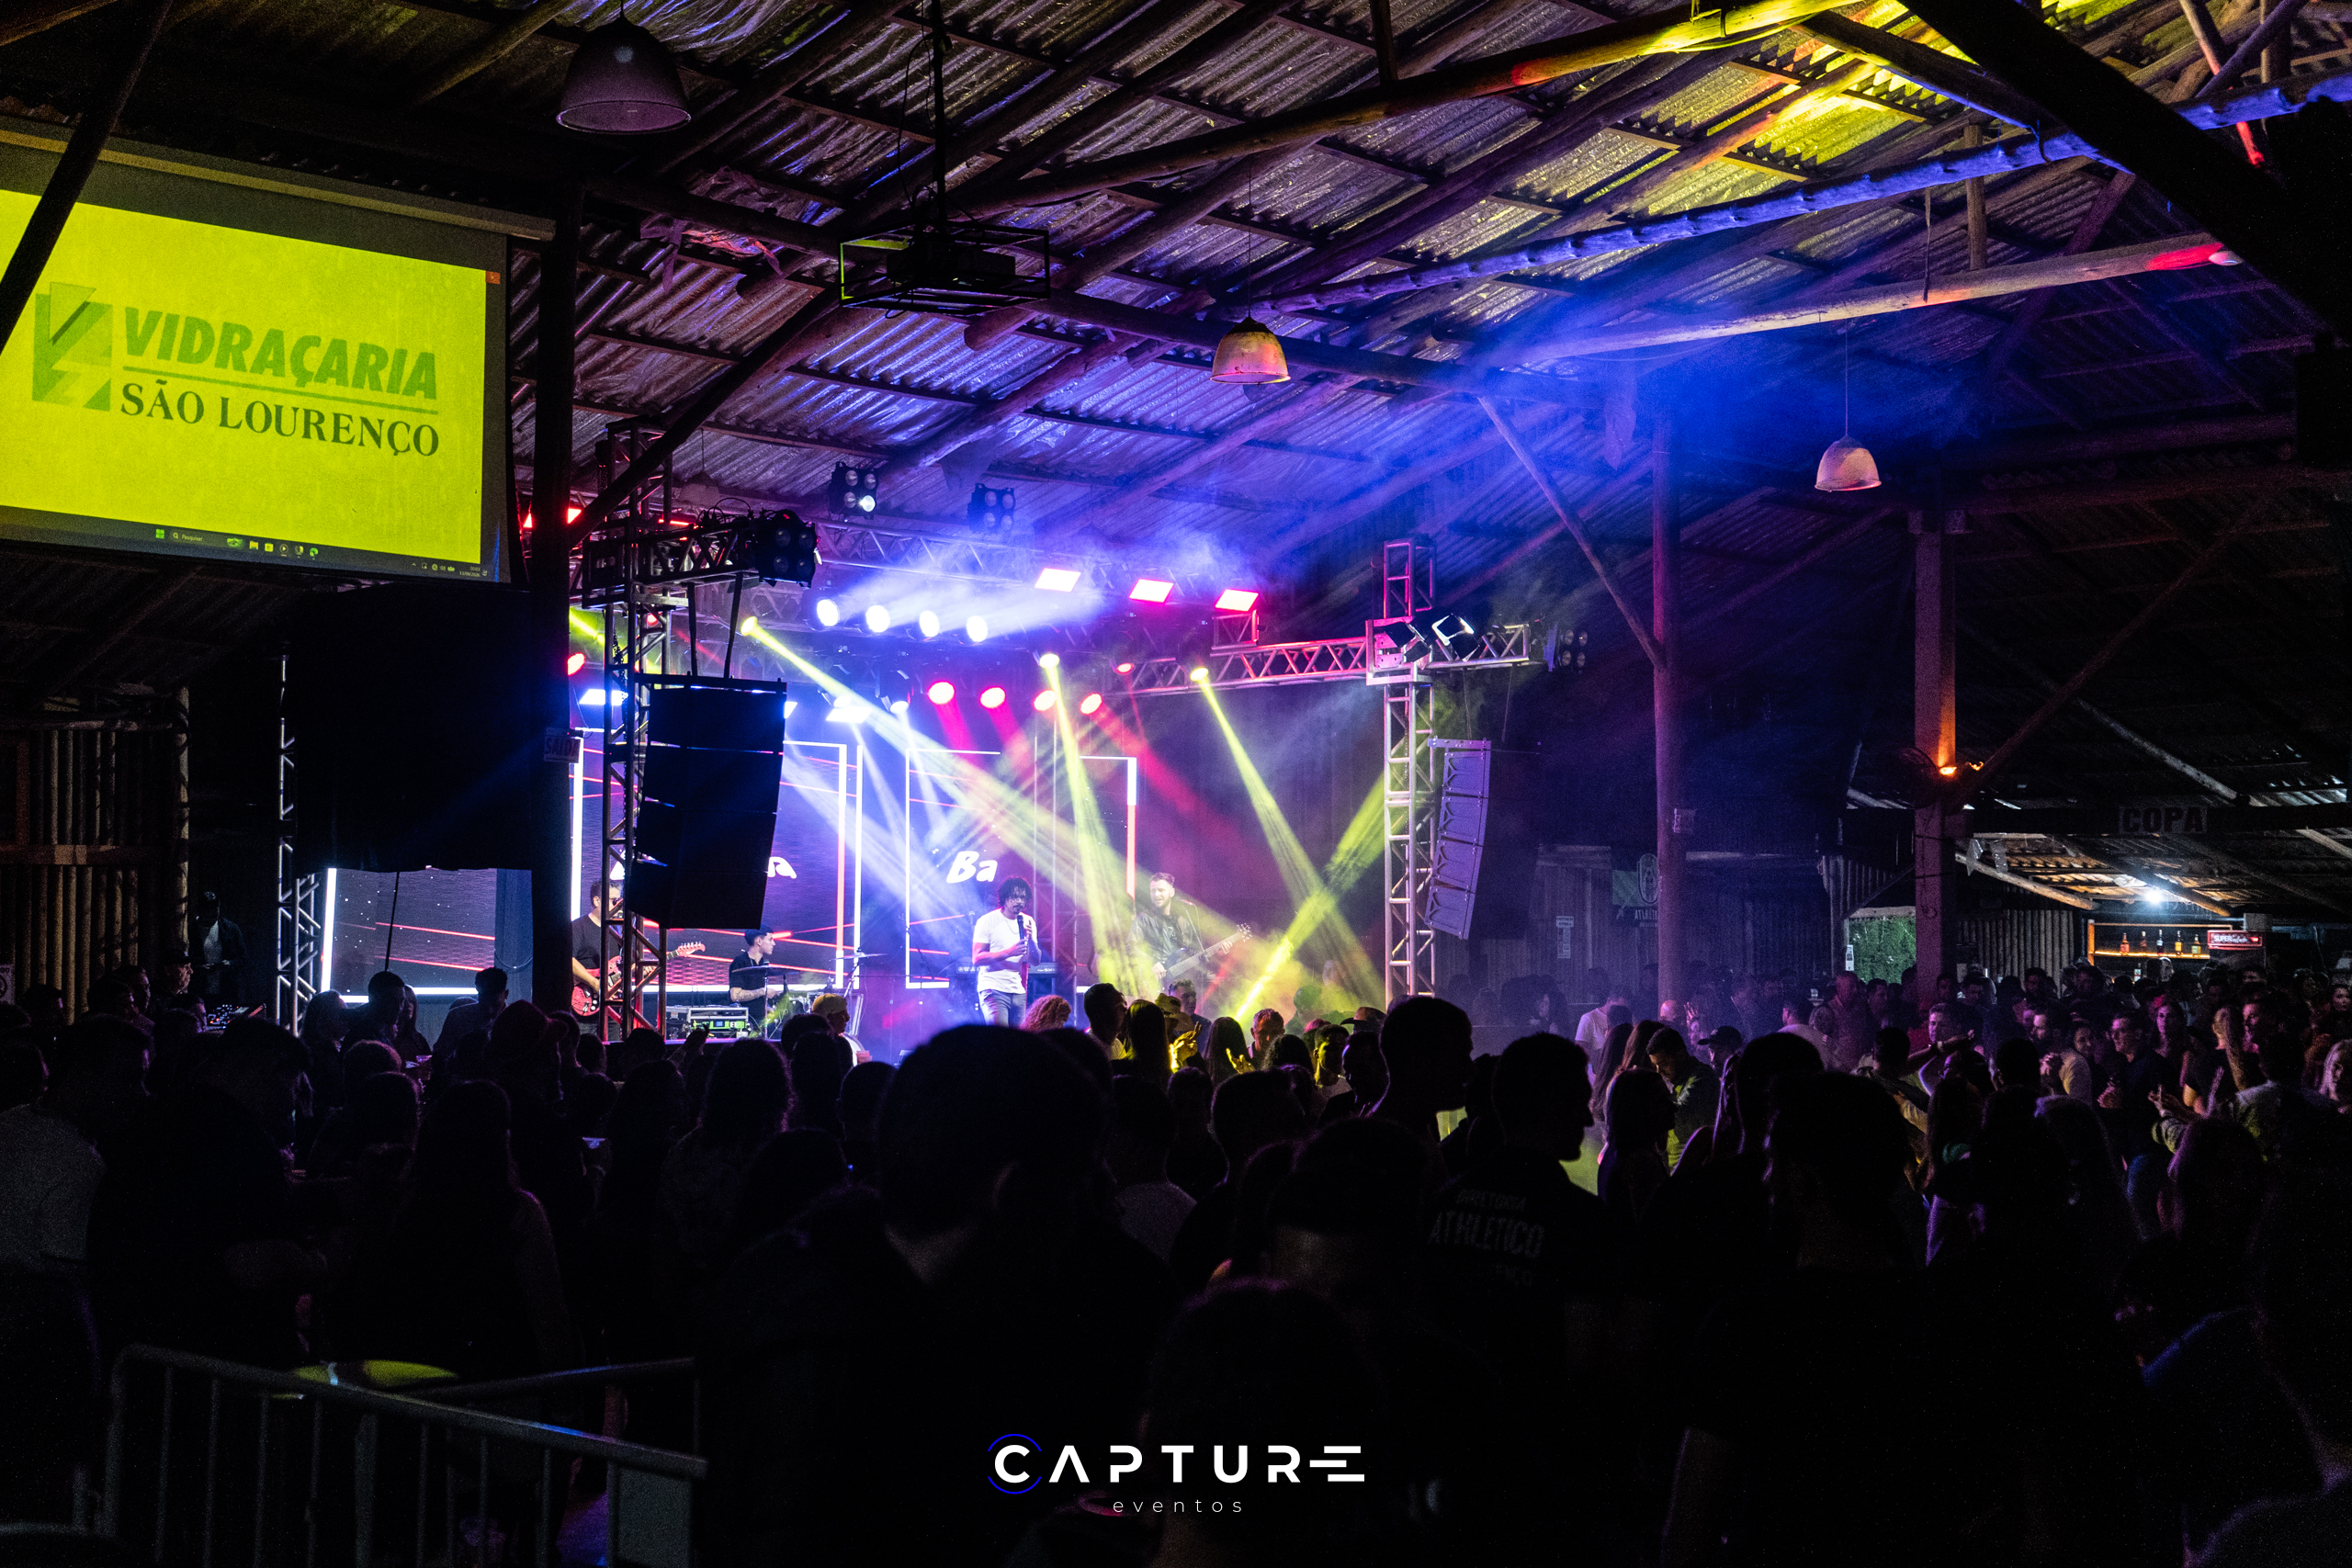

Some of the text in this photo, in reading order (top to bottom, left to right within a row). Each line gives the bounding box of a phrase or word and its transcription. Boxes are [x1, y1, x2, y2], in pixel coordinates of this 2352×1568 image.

[125, 307, 438, 400] VIDRAÇARIA
[120, 378, 439, 457] SÃO LOURENÇO
[2122, 807, 2203, 832] COPA
